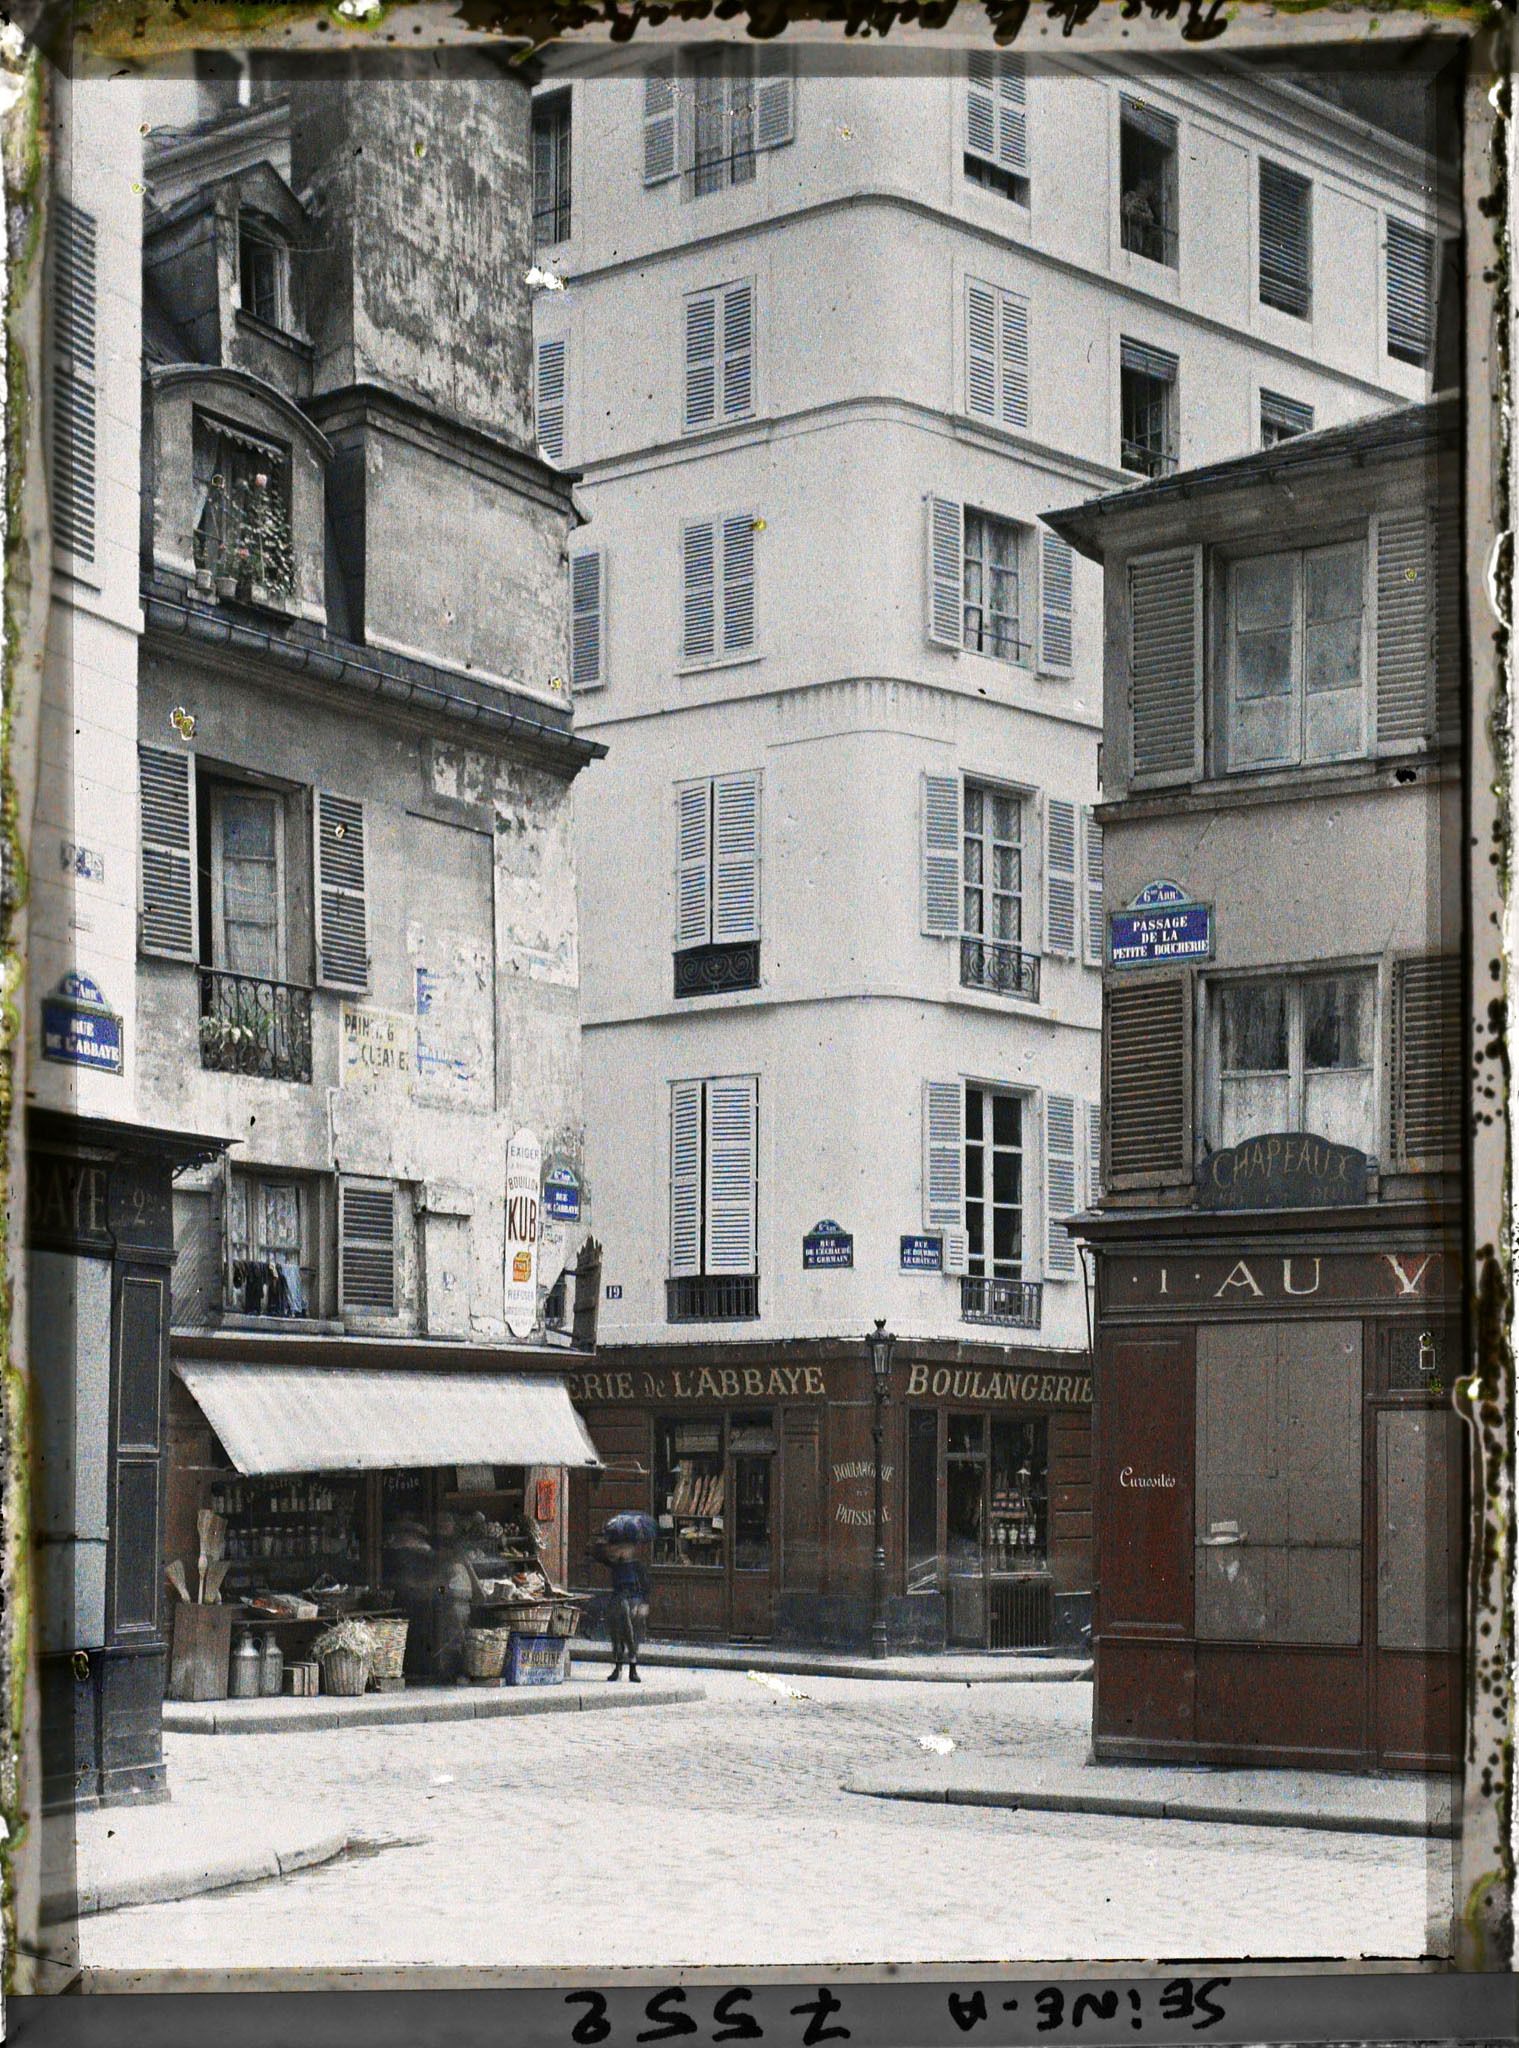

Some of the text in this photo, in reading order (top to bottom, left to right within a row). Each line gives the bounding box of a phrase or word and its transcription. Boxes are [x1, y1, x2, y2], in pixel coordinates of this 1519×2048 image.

[1133, 916, 1188, 932] PASSAGE
[1141, 930, 1178, 944] DE LA
[1113, 940, 1209, 960] PETITE BOUCHERIE
[71, 1018, 94, 1037] RUE
[65, 1034, 119, 1061] L'ABBAYE
[1212, 1138, 1357, 1188] CHAPEAUX
[508, 1195, 537, 1243] KUB
[805, 1248, 814, 1256] DE
[820, 1240, 835, 1248] RUE
[914, 1240, 928, 1248] RUE
[816, 1255, 848, 1264] GERMAIN
[1214, 1259, 1322, 1297] AU
[608, 1286, 620, 1299] 19
[672, 1366, 826, 1398] L'ABBAYE
[905, 1363, 1094, 1403] BOULANGERIE
[1120, 1466, 1176, 1488] Curiosités
